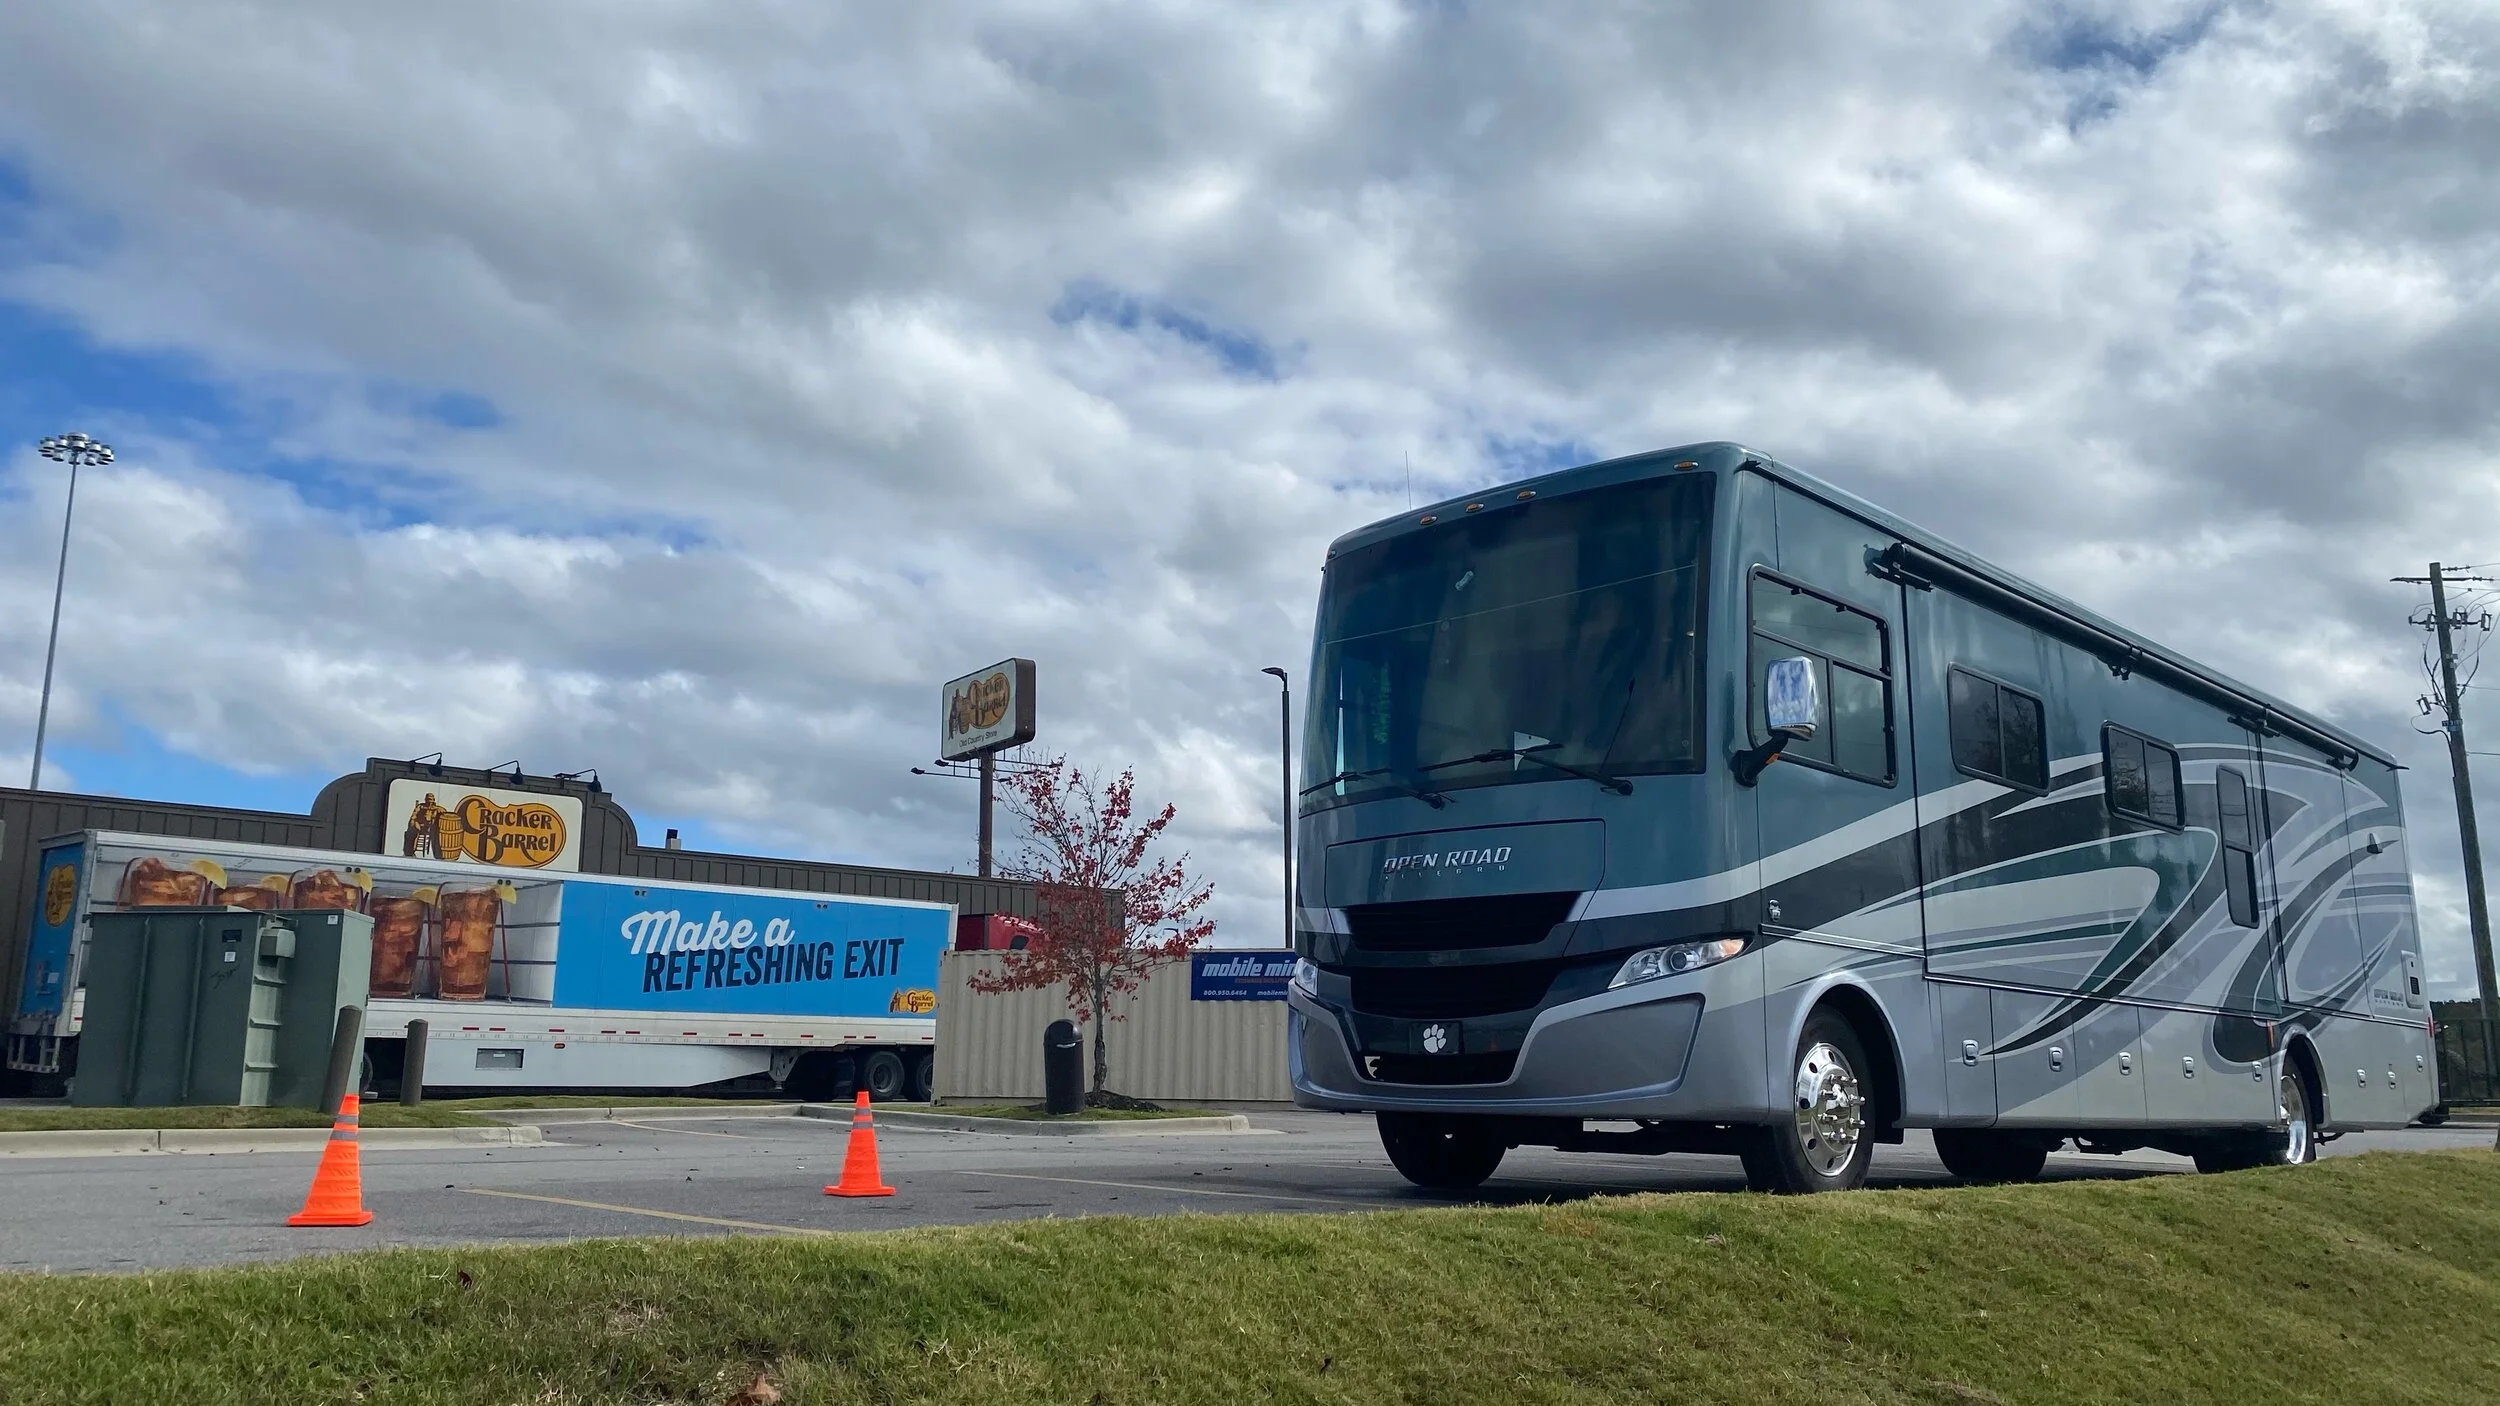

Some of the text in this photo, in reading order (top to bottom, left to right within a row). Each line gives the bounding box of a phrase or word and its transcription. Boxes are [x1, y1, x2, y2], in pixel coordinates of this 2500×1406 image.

[967, 734, 985, 745] Country
[985, 730, 998, 740] Store
[457, 799, 553, 834] Cracker
[477, 823, 556, 863] Barrel
[1383, 846, 1512, 874] OPEN ROAD
[621, 908, 796, 956] Make a
[642, 937, 905, 993] REFRESHING EXIT
[1202, 957, 1297, 977] mobile min
